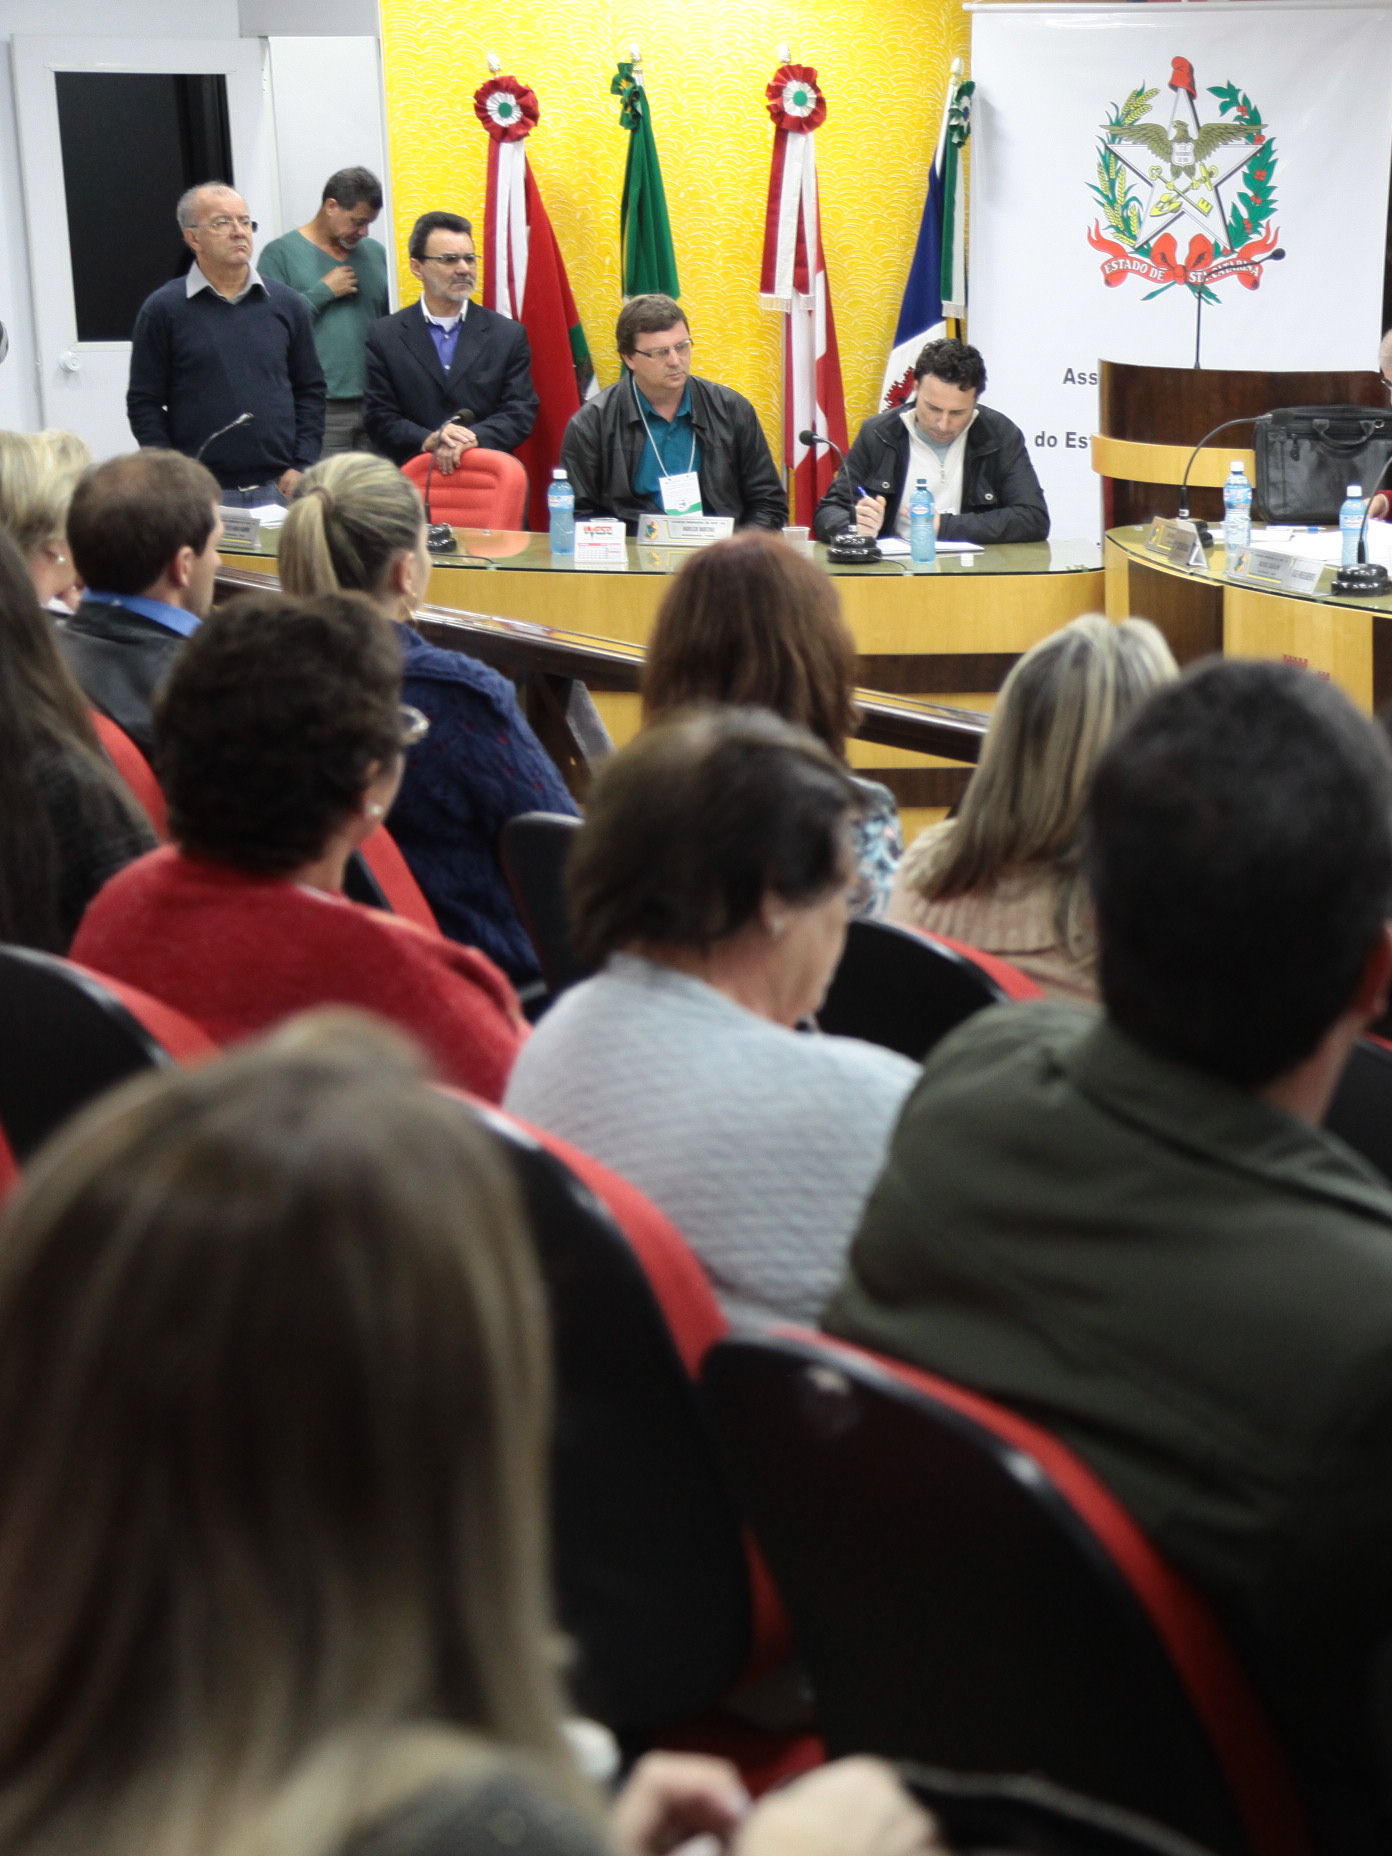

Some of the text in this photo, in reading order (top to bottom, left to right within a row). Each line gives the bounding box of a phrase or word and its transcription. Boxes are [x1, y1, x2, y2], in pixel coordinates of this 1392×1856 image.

[1104, 258, 1148, 275] ESTADO
[1150, 267, 1166, 282] DE
[1034, 430, 1058, 448] do
